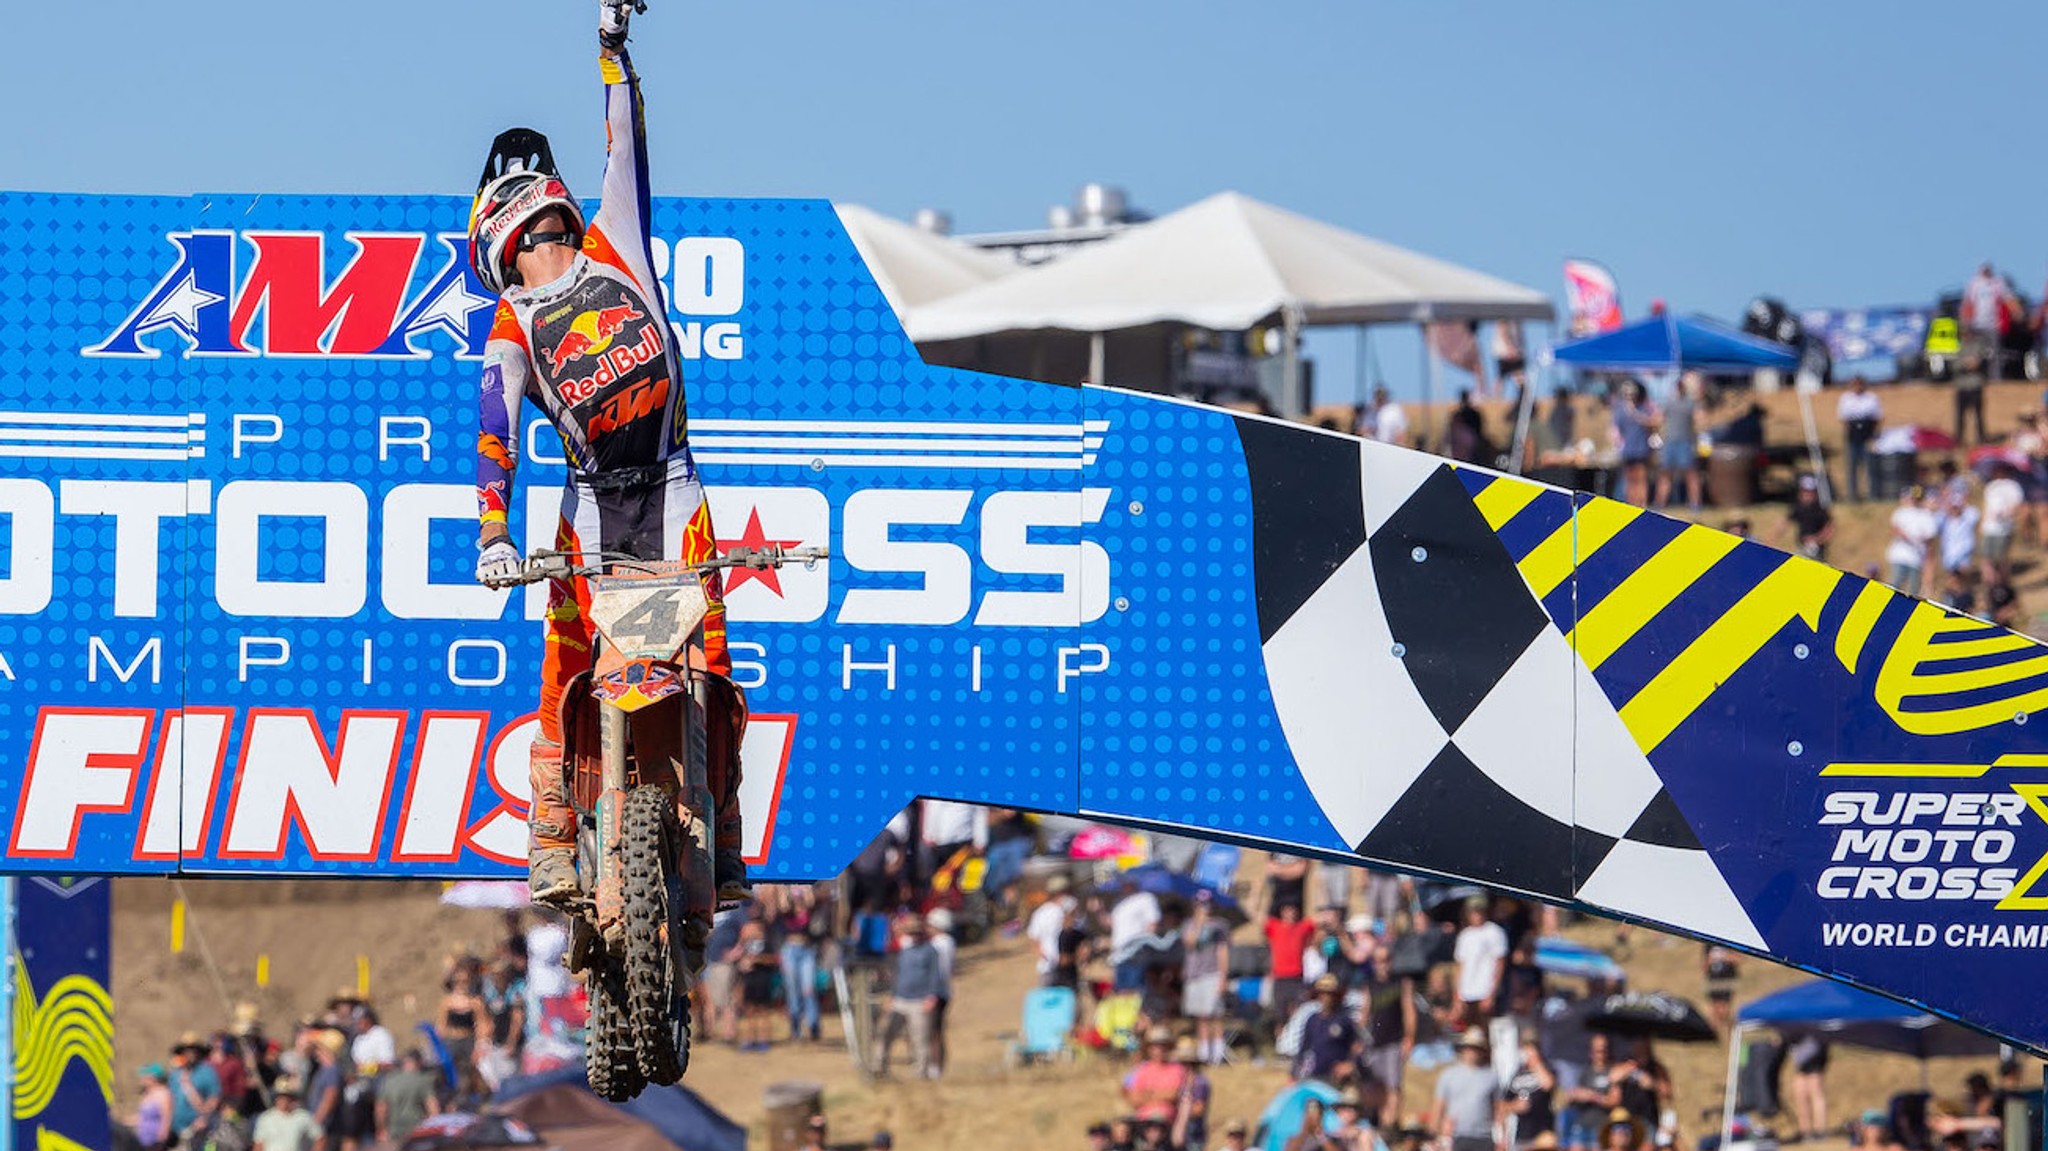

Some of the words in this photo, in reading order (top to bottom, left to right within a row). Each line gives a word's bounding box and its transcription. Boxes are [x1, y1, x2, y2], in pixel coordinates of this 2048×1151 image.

[81, 230, 500, 359] AMA
[557, 353, 617, 409] Red
[610, 322, 664, 377] Bull
[587, 377, 670, 443] KTM
[611, 588, 681, 646] 4
[1817, 792, 2027, 826] SUPER
[1831, 829, 2016, 863] MOTO
[1816, 867, 2019, 900] CROSS
[1822, 923, 1937, 947] WORLD
